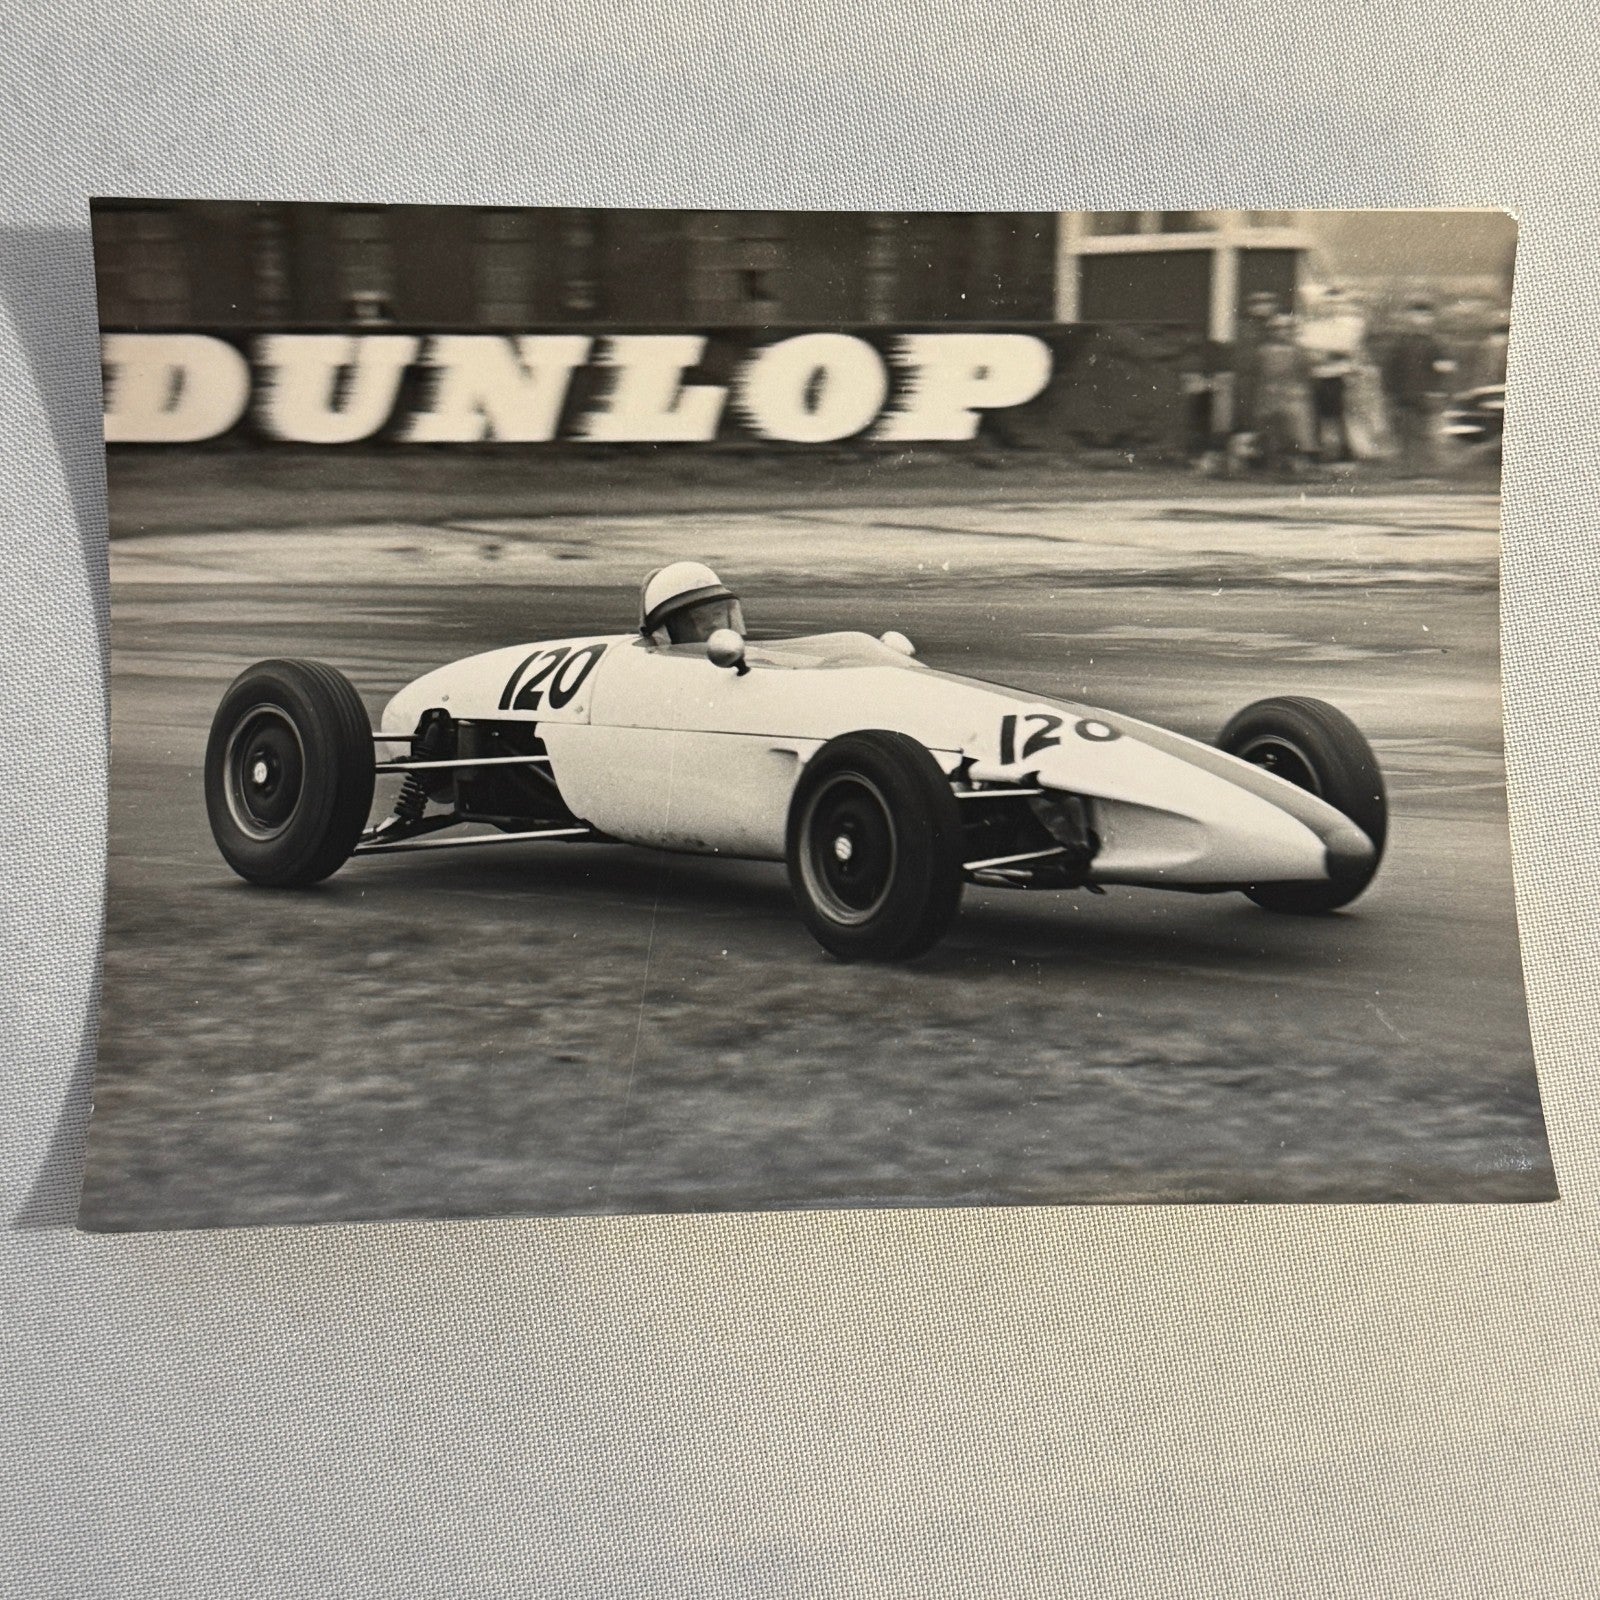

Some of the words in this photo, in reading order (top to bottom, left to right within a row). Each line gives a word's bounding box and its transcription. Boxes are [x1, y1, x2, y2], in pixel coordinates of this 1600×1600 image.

[102, 333, 1053, 443] DUNLOP
[498, 643, 608, 711] 120
[1000, 714, 1122, 765] 120
